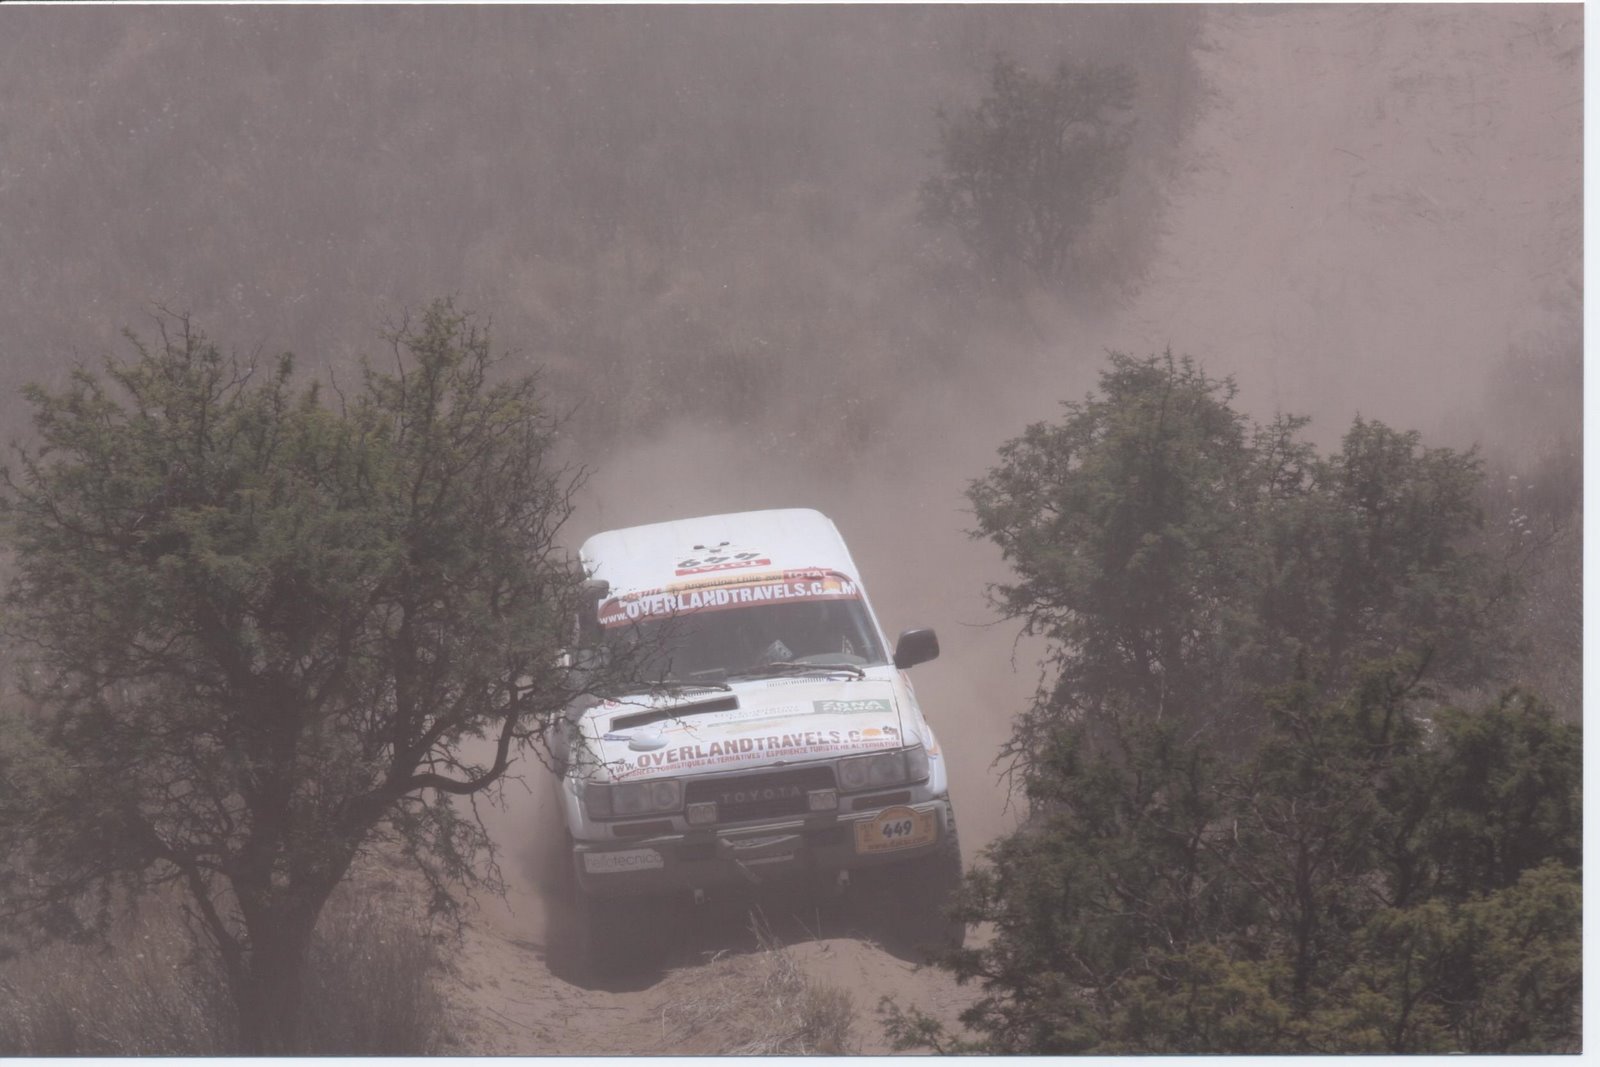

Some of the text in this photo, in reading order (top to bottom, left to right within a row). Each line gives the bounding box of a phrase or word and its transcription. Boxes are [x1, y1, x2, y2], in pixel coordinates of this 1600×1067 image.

[821, 699, 882, 708] ZONA
[707, 752, 760, 765] ALTERNATIVES
[720, 786, 801, 804] TOYOTA
[882, 819, 912, 838] 449
